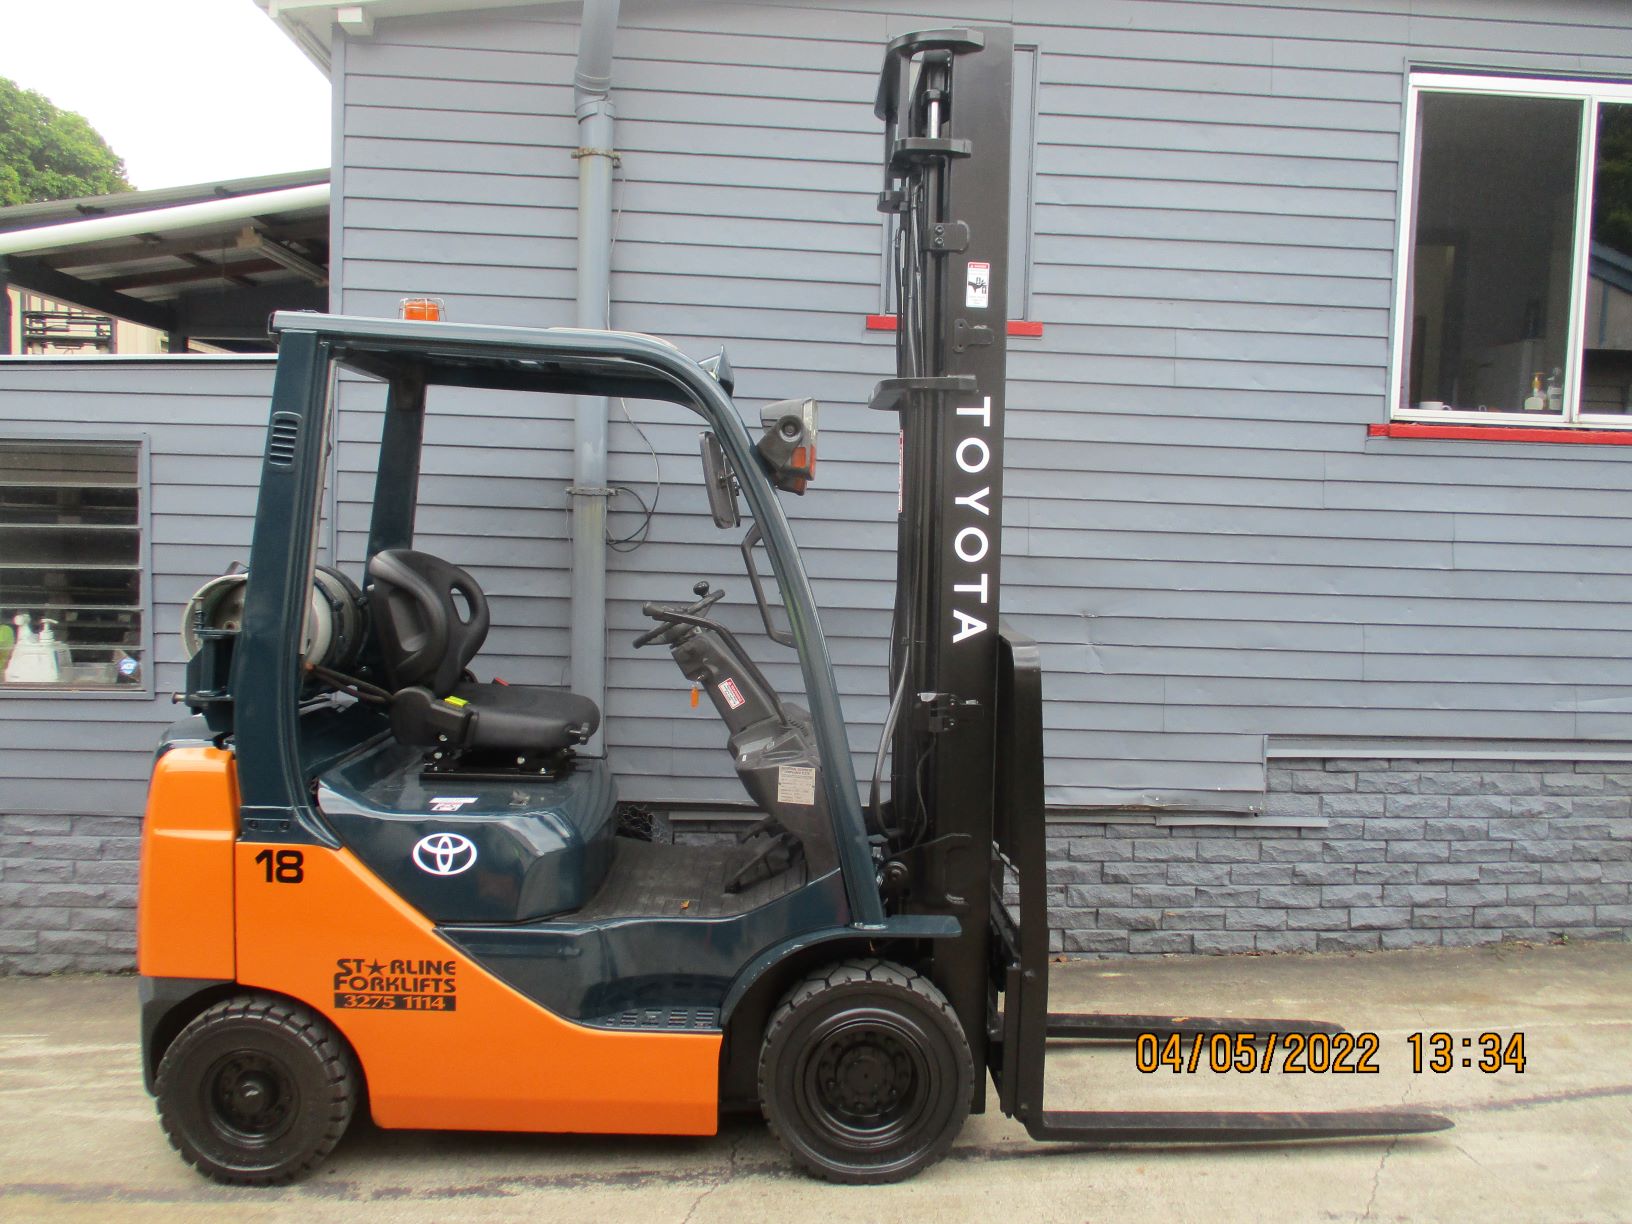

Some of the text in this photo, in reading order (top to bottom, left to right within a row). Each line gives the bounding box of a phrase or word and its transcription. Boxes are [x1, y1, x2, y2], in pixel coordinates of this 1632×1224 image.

[953, 397, 991, 643] TOYOTA
[255, 849, 304, 884] 18
[334, 973, 457, 993] FORKLIFTS
[343, 994, 446, 1010] 3275 1114
